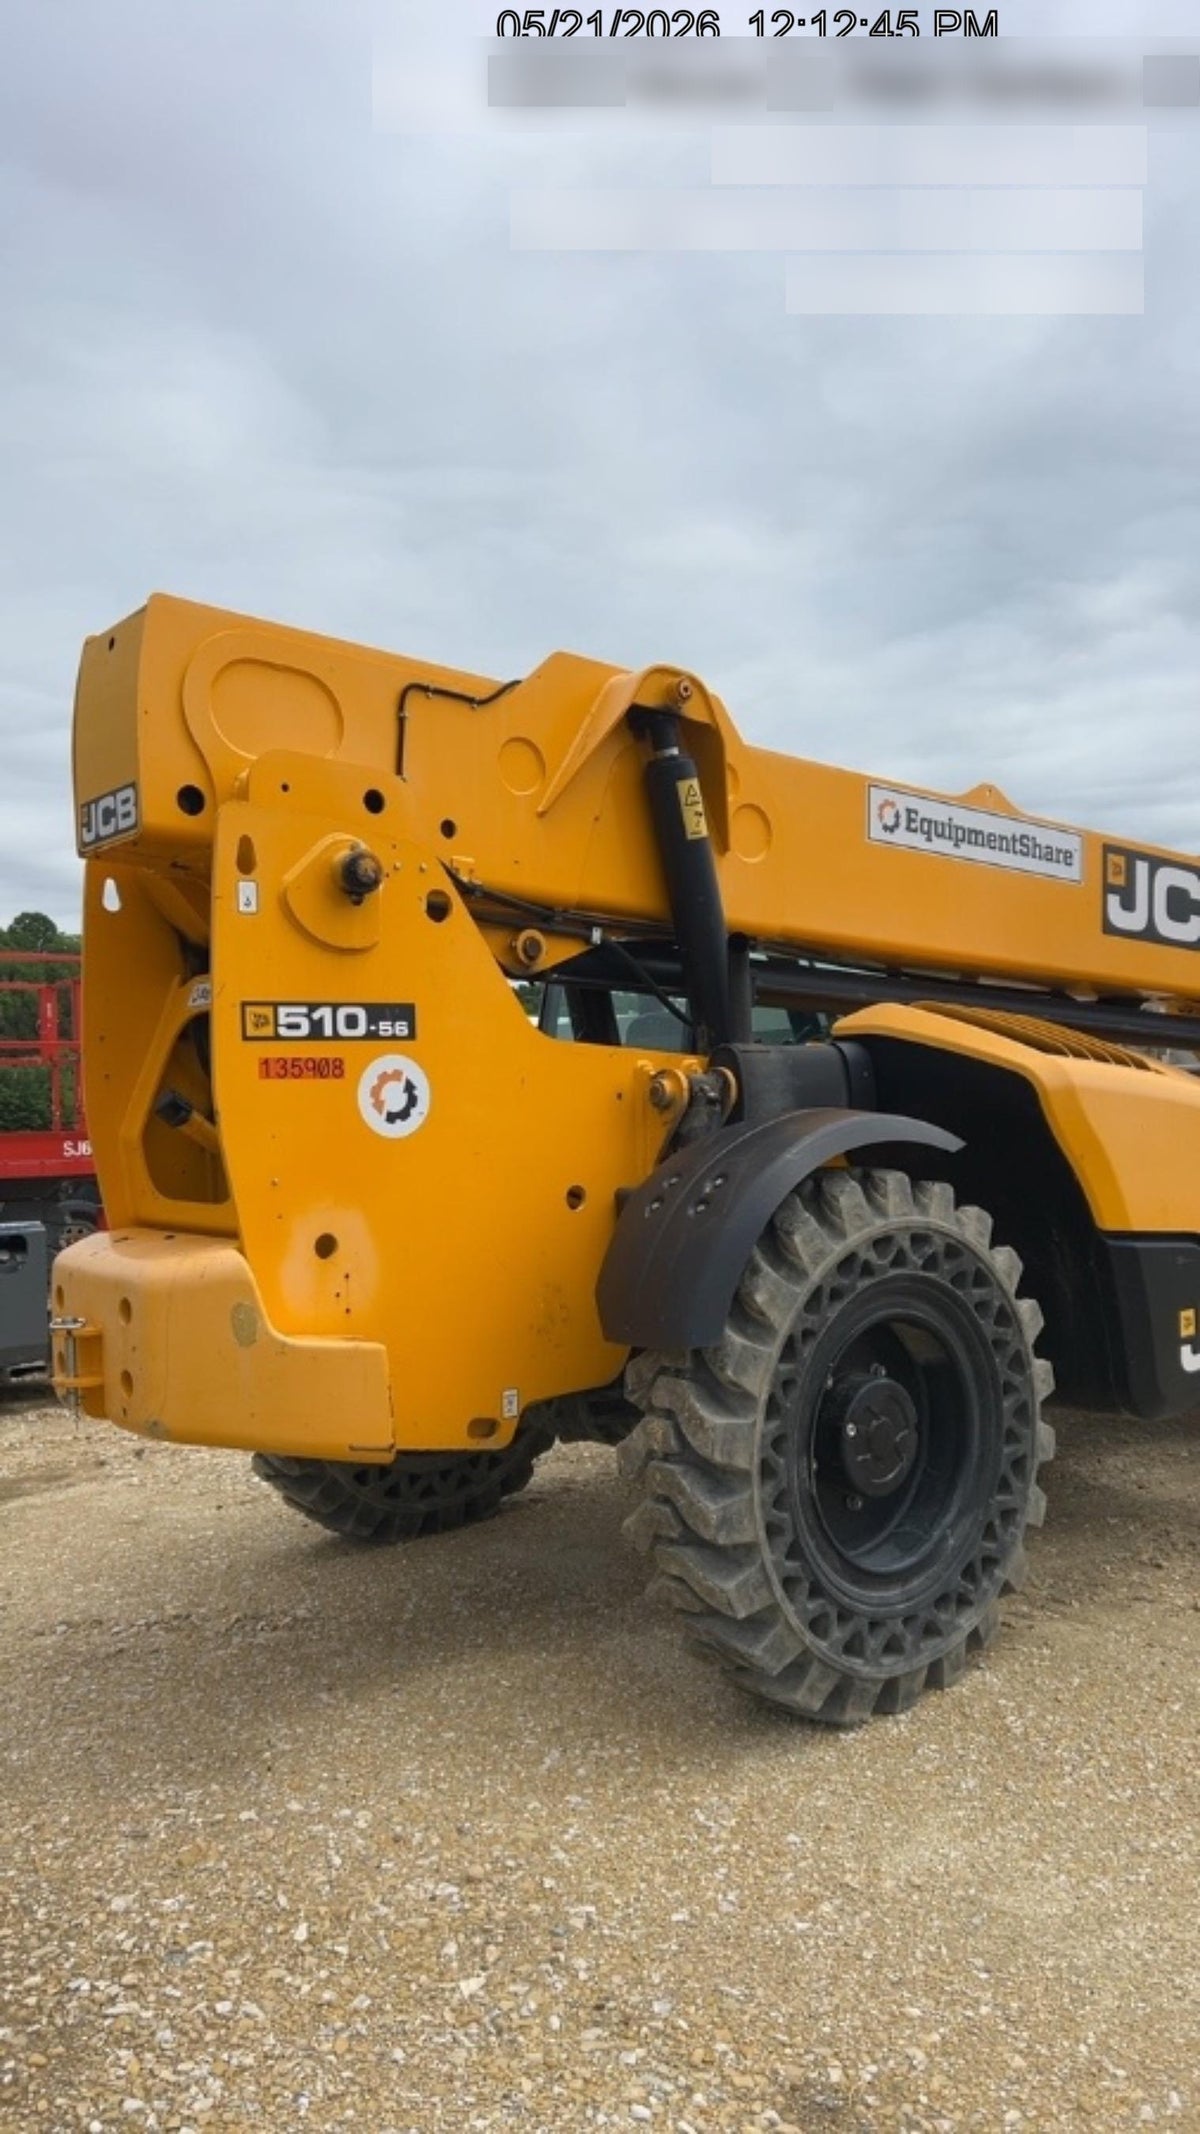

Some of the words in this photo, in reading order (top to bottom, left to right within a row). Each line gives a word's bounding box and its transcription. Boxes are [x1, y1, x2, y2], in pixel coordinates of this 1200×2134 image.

[82, 786, 137, 843] JCB
[904, 807, 1075, 868] EquipmentShare
[260, 1057, 345, 1079] 135908
